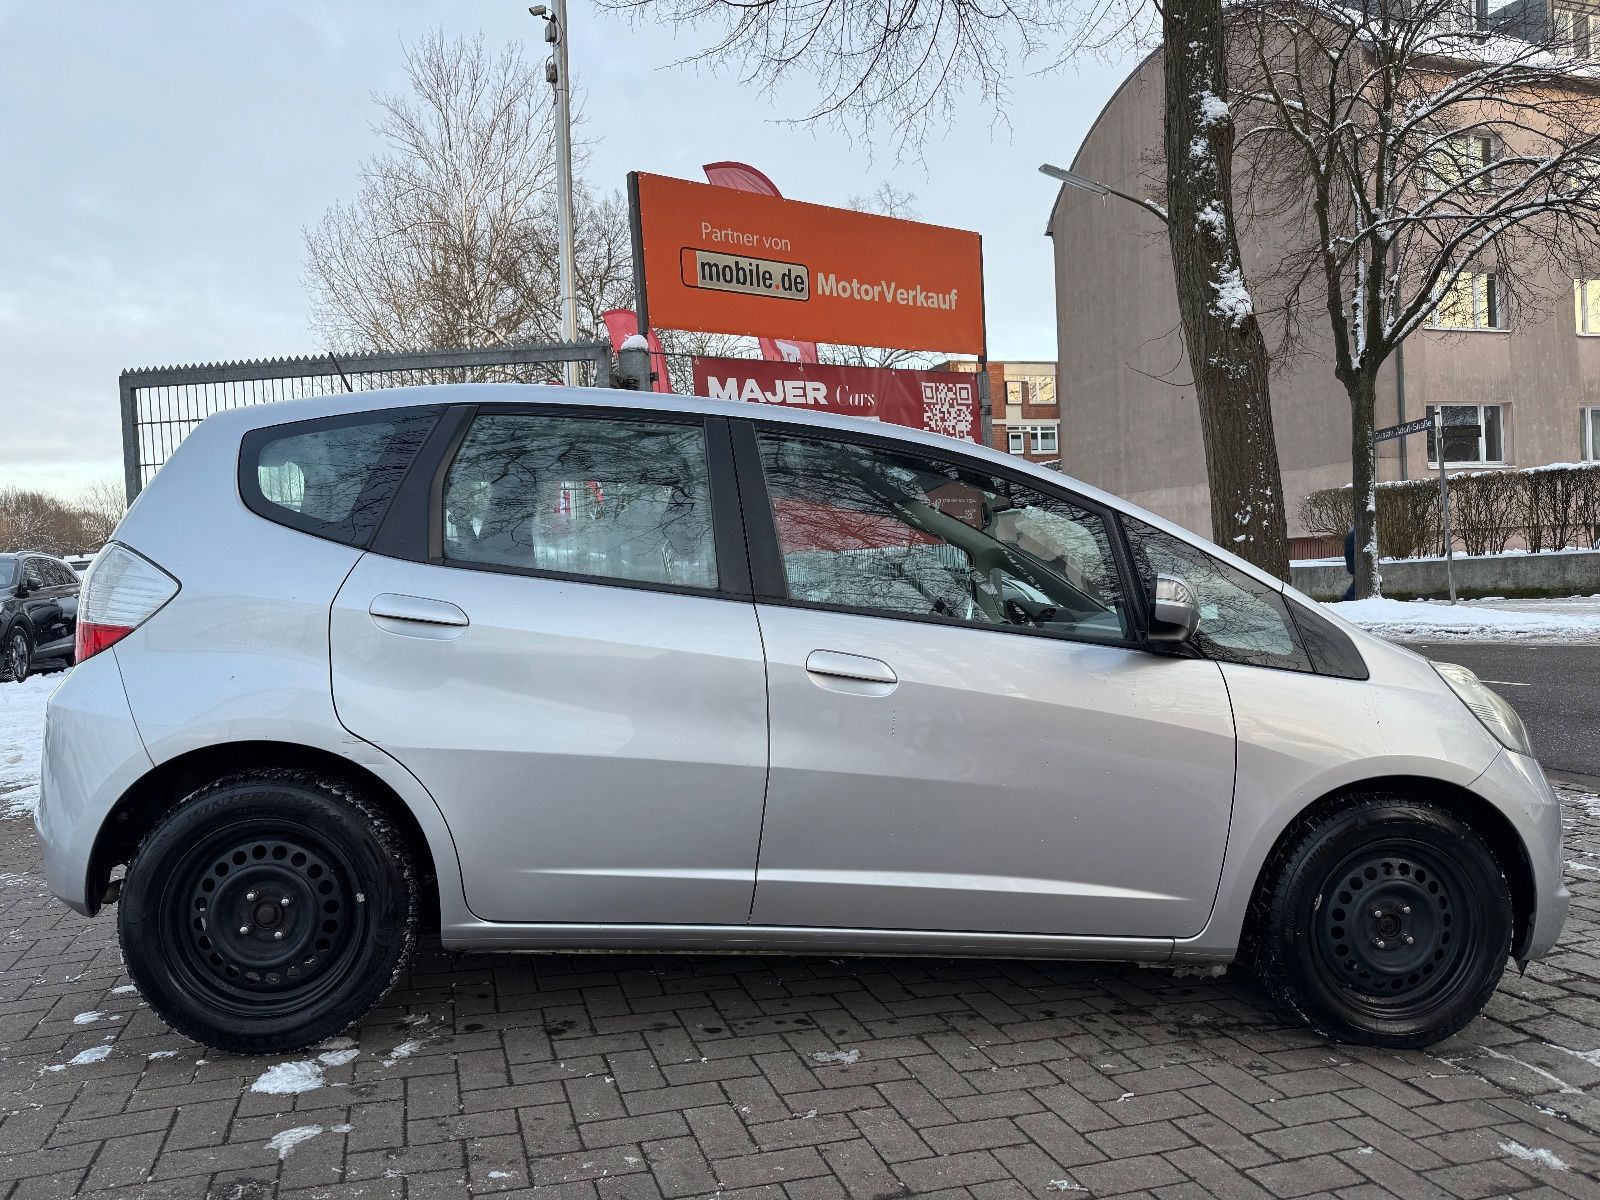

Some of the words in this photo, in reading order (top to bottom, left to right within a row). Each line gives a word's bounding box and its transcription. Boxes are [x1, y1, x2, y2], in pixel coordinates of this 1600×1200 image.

[701, 221, 759, 247] Partner
[763, 234, 791, 251] von
[700, 260, 805, 293] mobile.de
[817, 272, 957, 310] MotorVerkauf
[707, 375, 828, 405] MAJER
[835, 384, 875, 407] Cars
